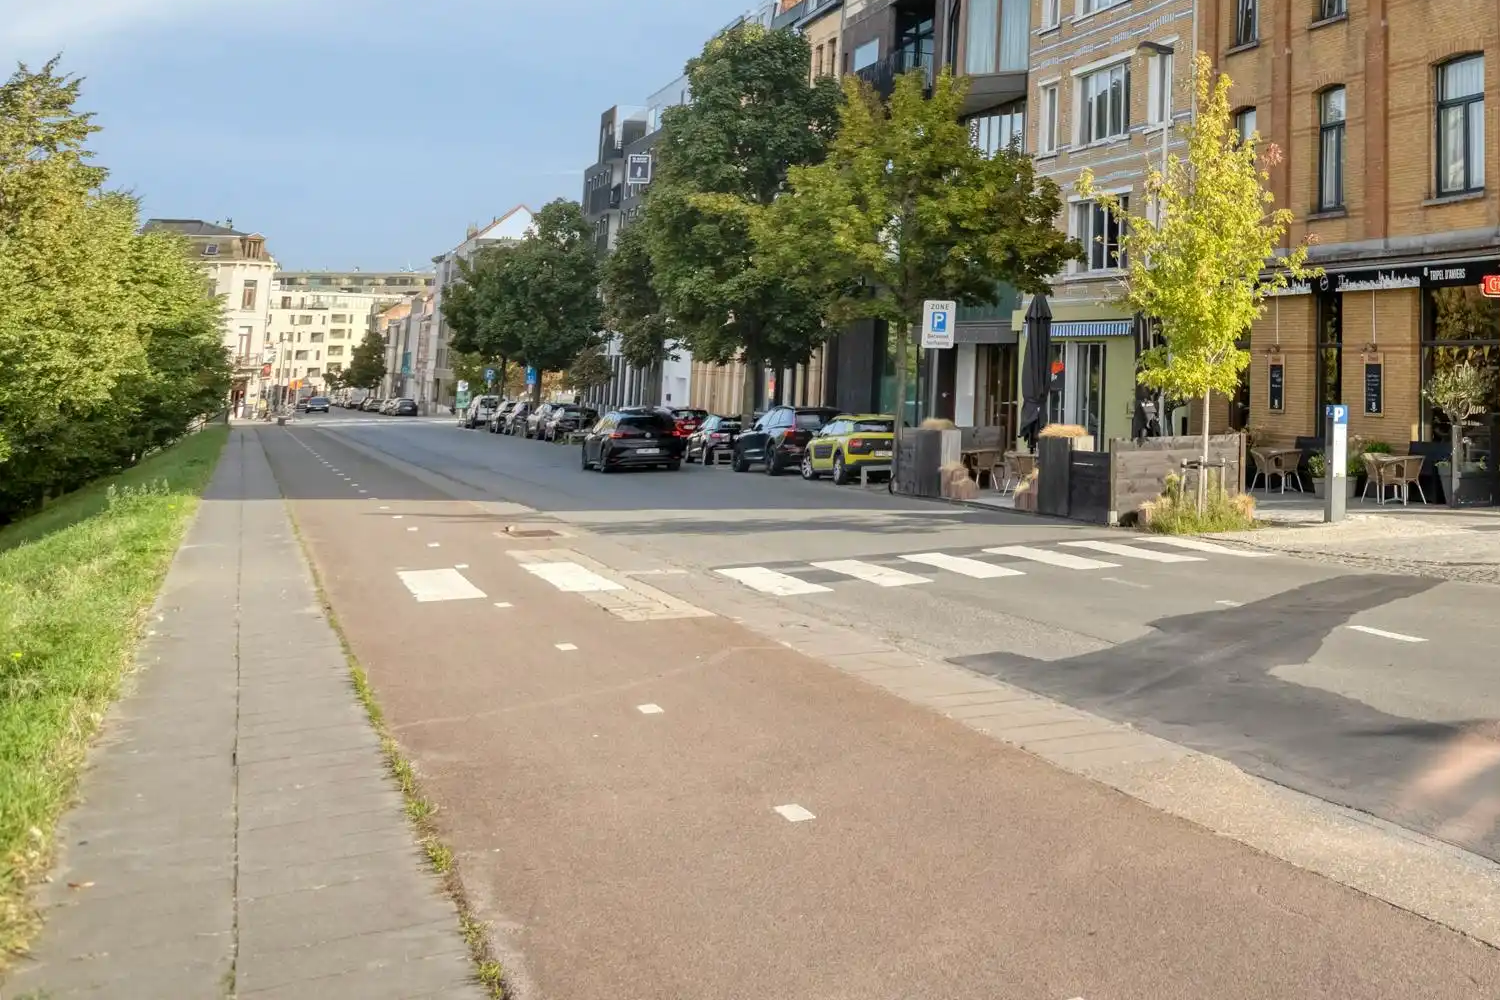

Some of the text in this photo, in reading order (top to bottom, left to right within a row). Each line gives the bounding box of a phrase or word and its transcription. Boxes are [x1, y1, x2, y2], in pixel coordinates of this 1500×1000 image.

[1430, 268, 1466, 280] TRIPEL D'ANVERS
[933, 313, 945, 328] P
[1334, 407, 1344, 422] P
